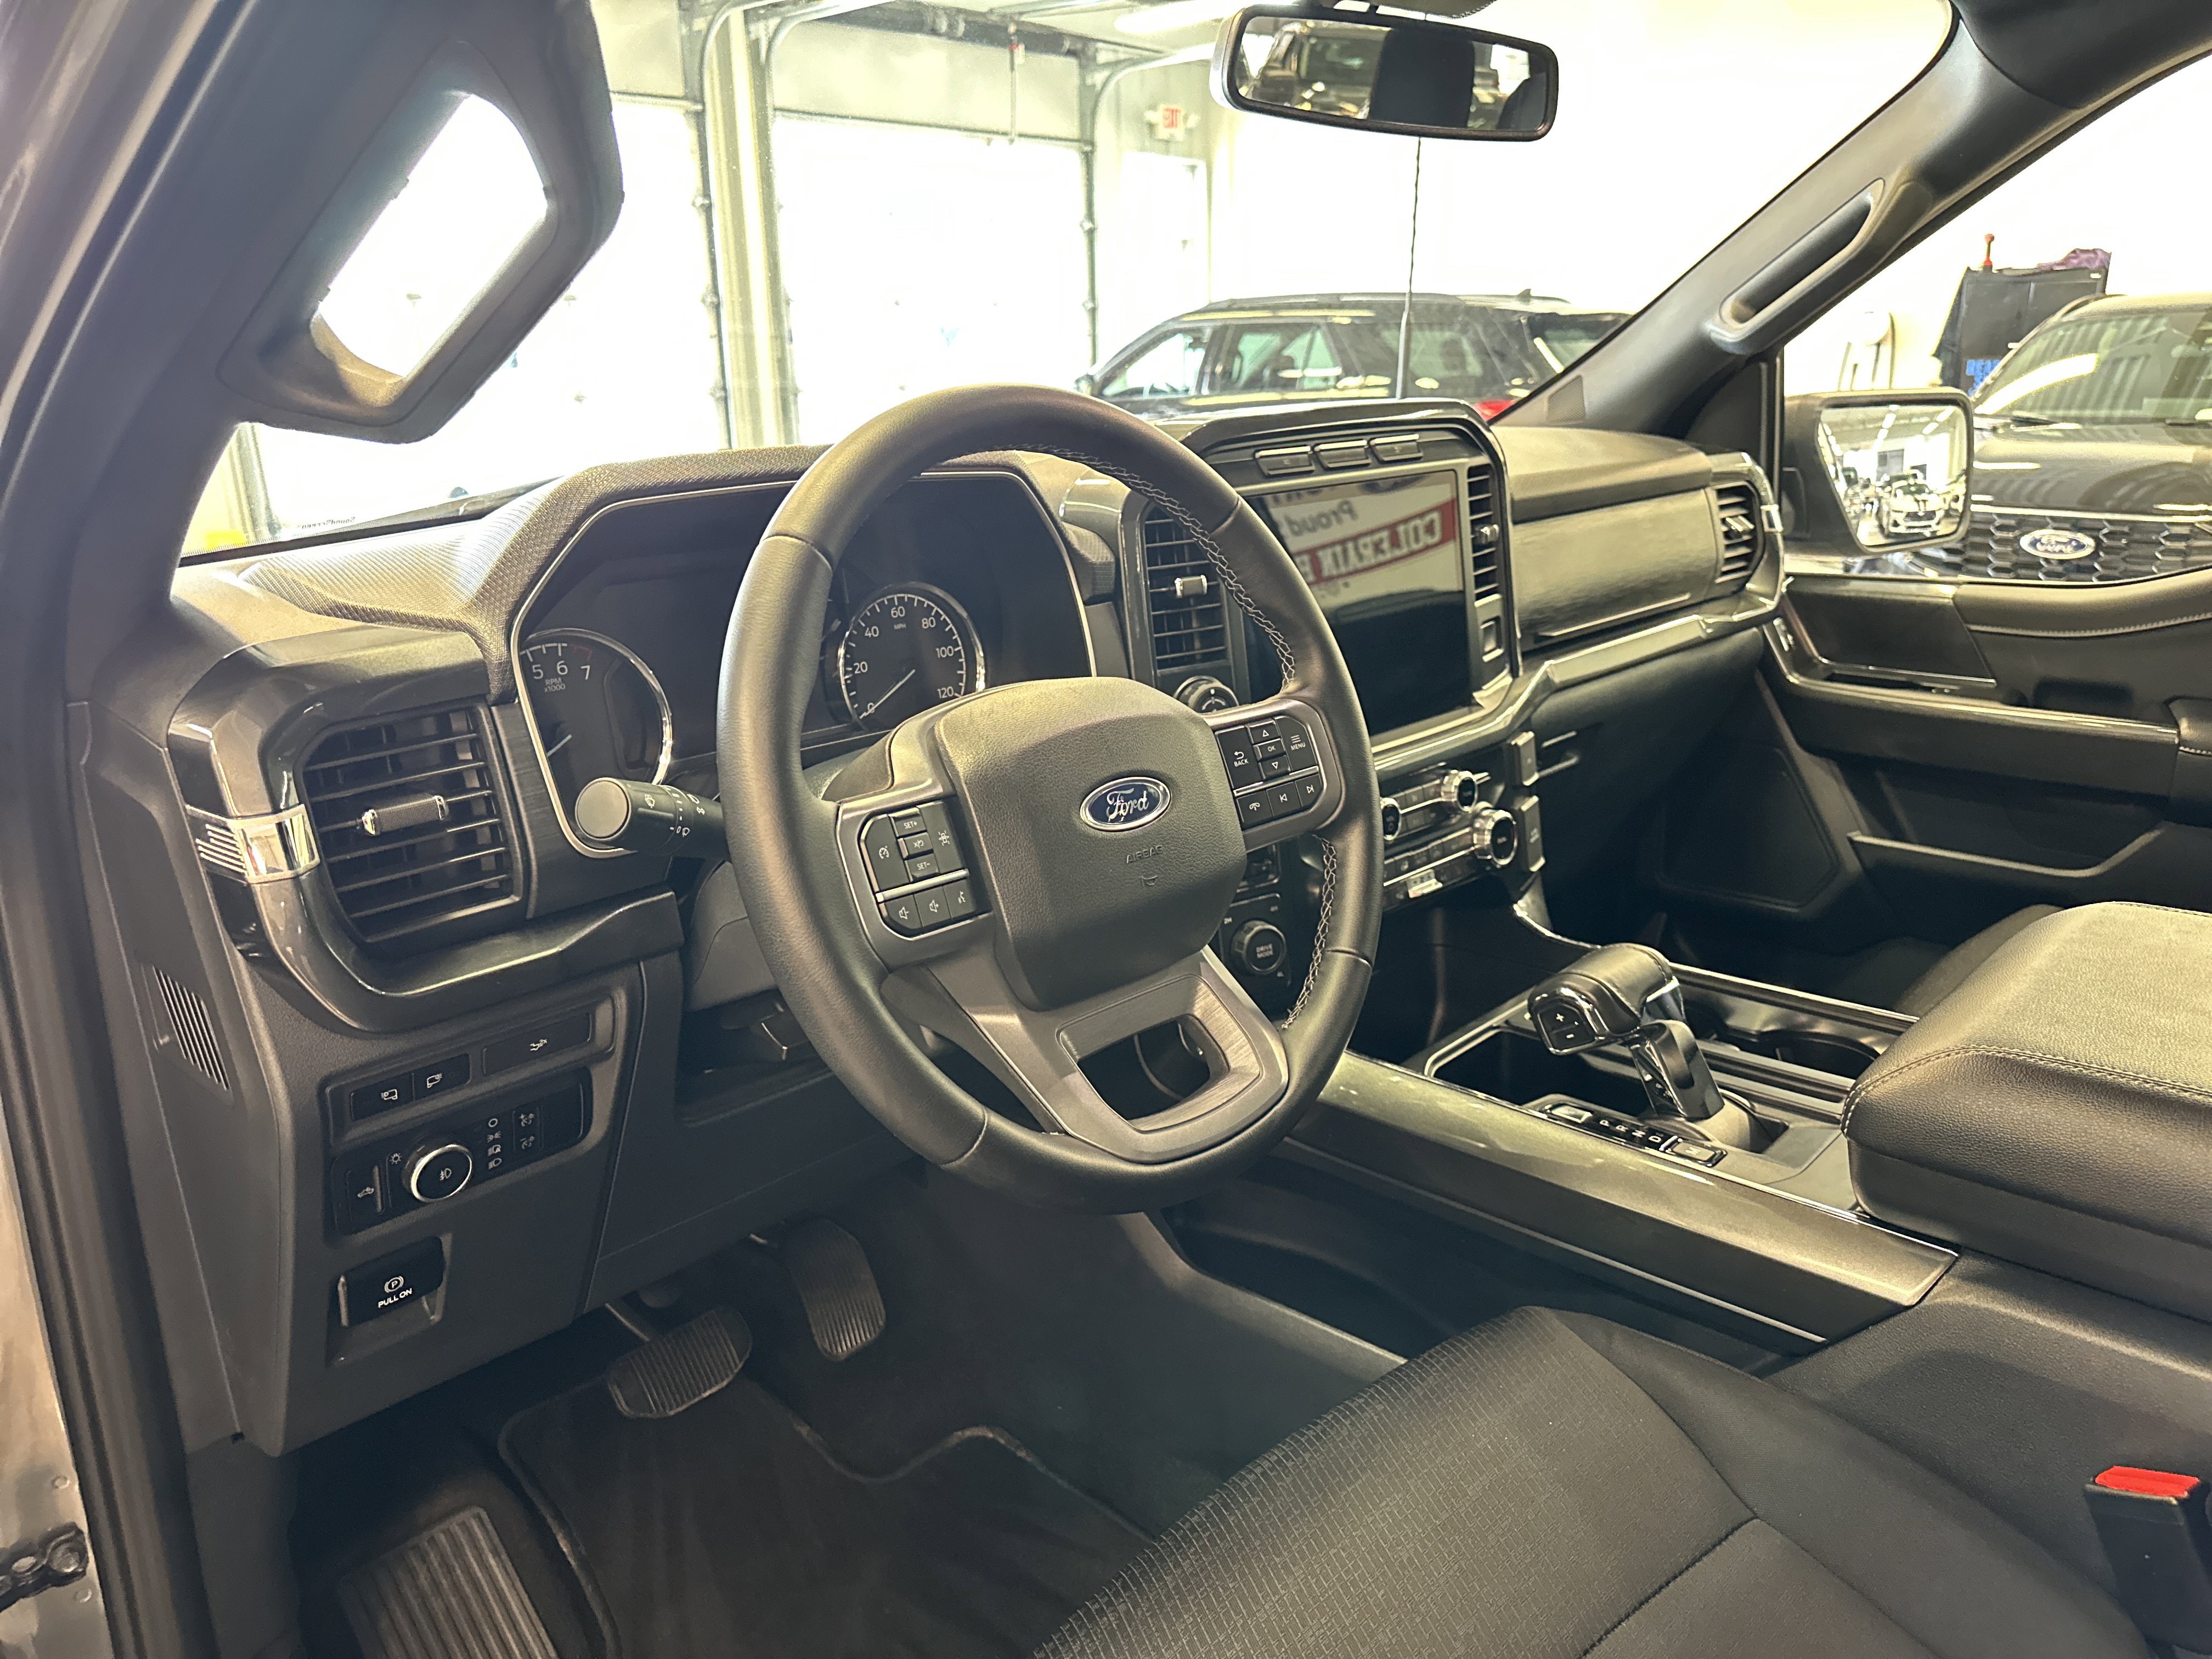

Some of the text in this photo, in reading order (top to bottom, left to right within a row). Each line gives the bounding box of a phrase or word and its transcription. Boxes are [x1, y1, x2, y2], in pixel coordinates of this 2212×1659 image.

[891, 606, 905, 618] 60
[922, 617, 936, 629] 80
[865, 626, 879, 637] 40
[936, 646, 954, 658] 100
[532, 664, 544, 680] 5
[556, 661, 568, 675] 6
[580, 665, 591, 680] 7
[853, 661, 868, 674] 20
[545, 678, 562, 686] RPM
[544, 684, 566, 693] x1000
[937, 686, 954, 699] 120
[1290, 742, 1306, 751] MENU
[1234, 758, 1249, 767] BACK
[1105, 787, 1150, 820] Ford
[1126, 844, 1165, 864] AIRBAG
[1256, 944, 1273, 952] DRIVE
[1256, 950, 1273, 959] MODE
[377, 1288, 413, 1308] PULL ON
